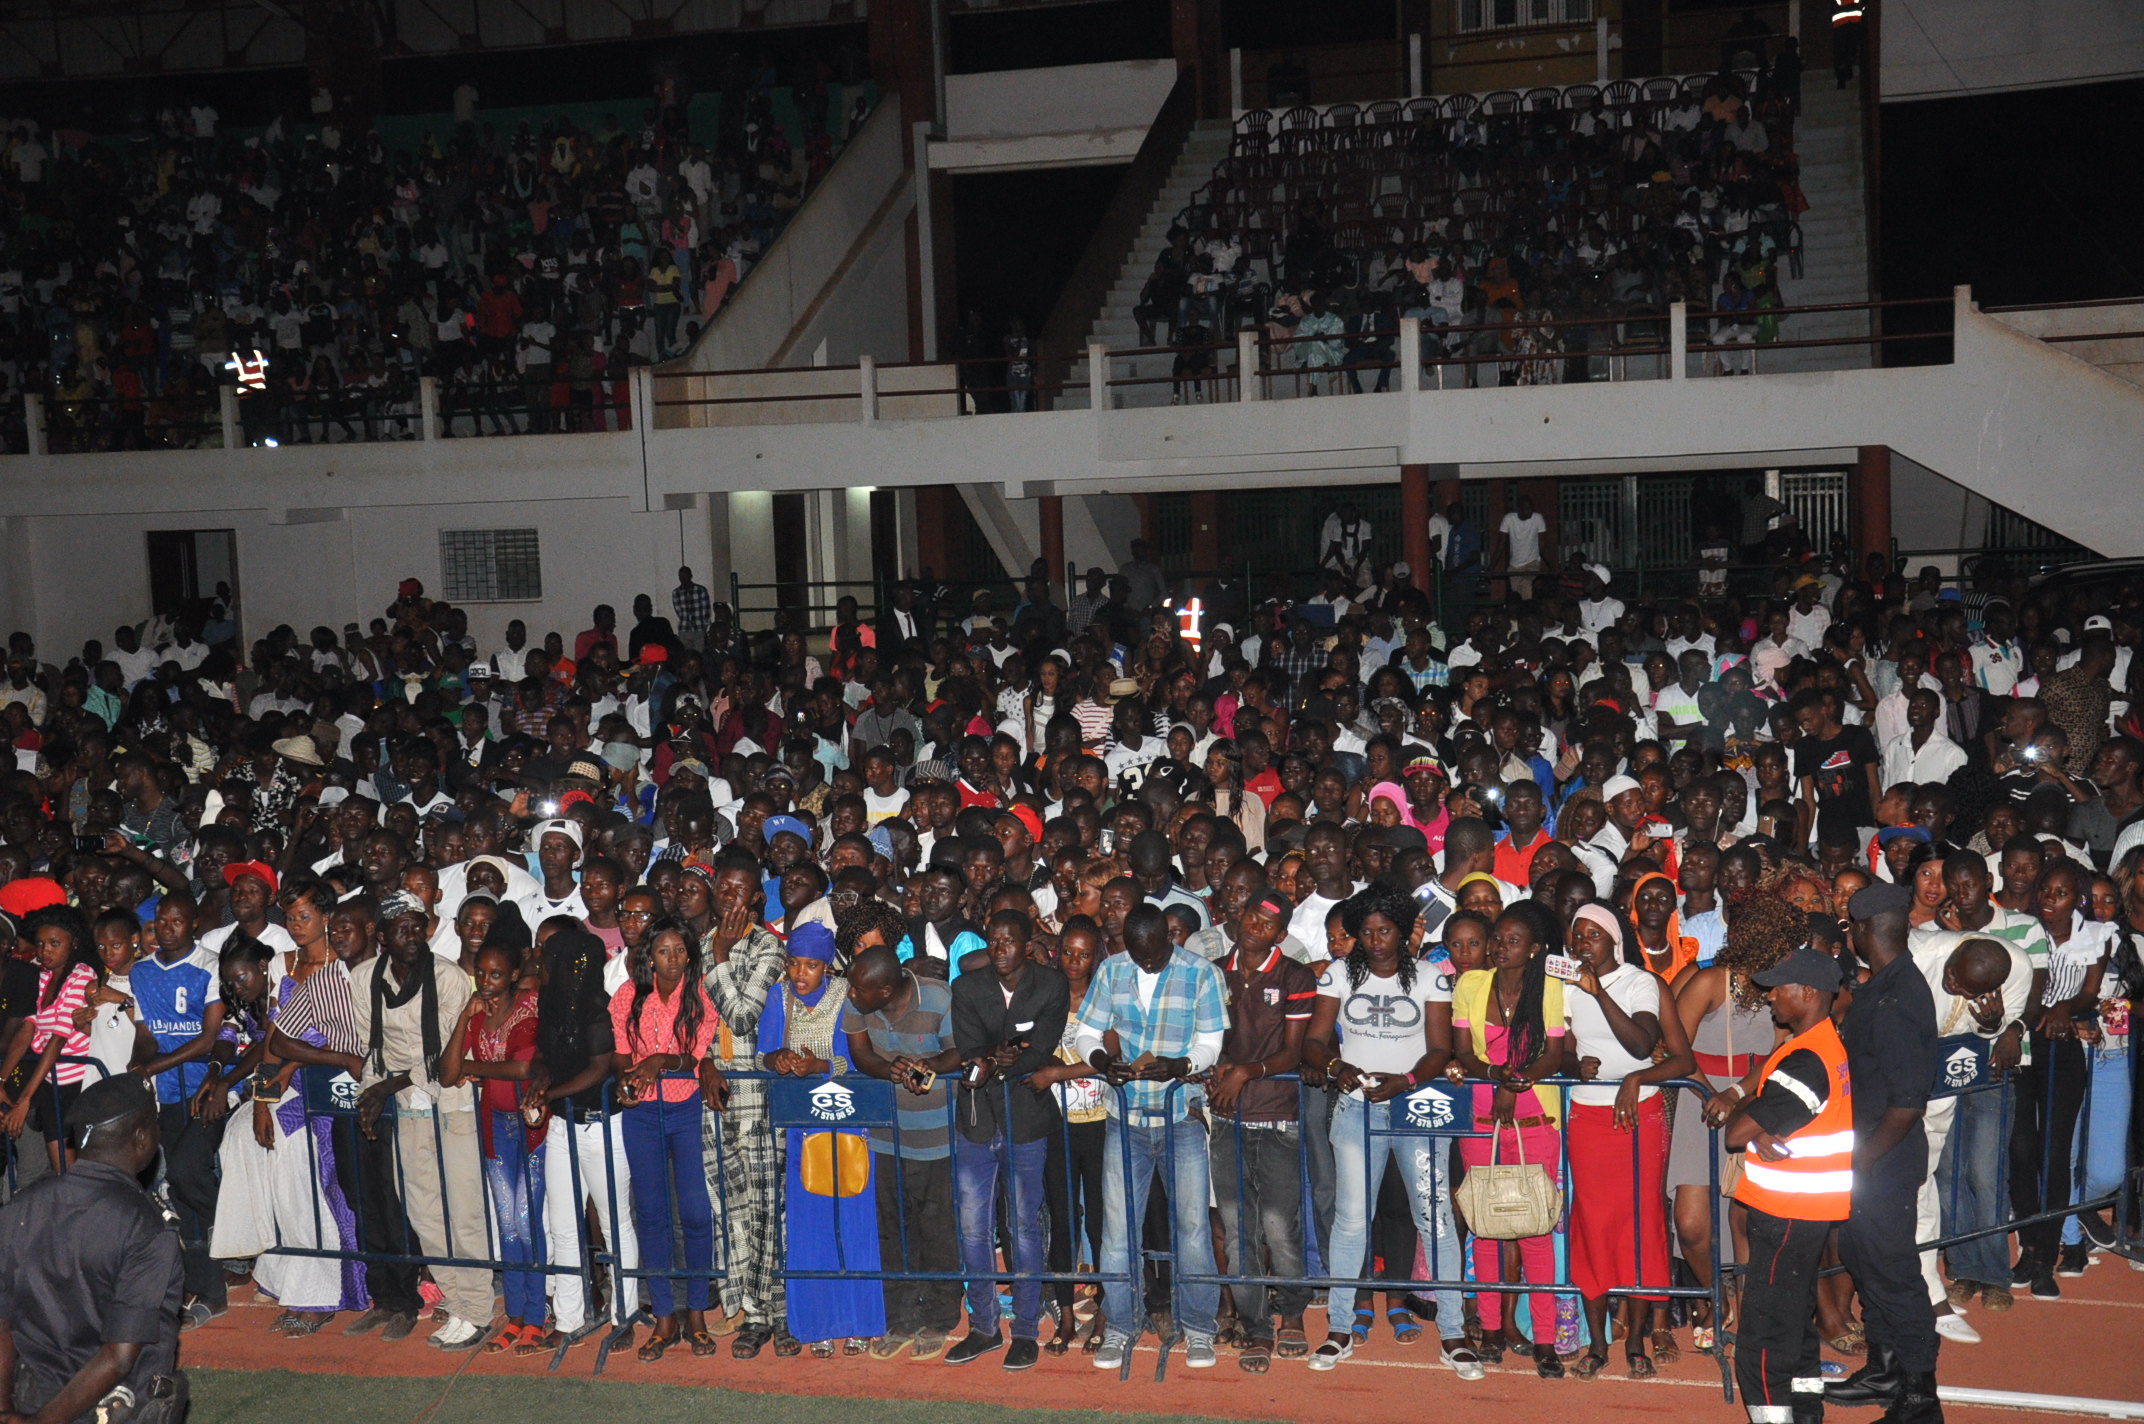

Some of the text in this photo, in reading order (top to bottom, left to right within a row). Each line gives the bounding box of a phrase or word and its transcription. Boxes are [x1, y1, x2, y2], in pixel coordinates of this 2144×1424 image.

[175, 986, 188, 1014] 6
[1946, 1057, 1977, 1075] GS
[331, 1082, 361, 1097] GS
[812, 1093, 853, 1108] GS
[1408, 1099, 1452, 1115] GS
